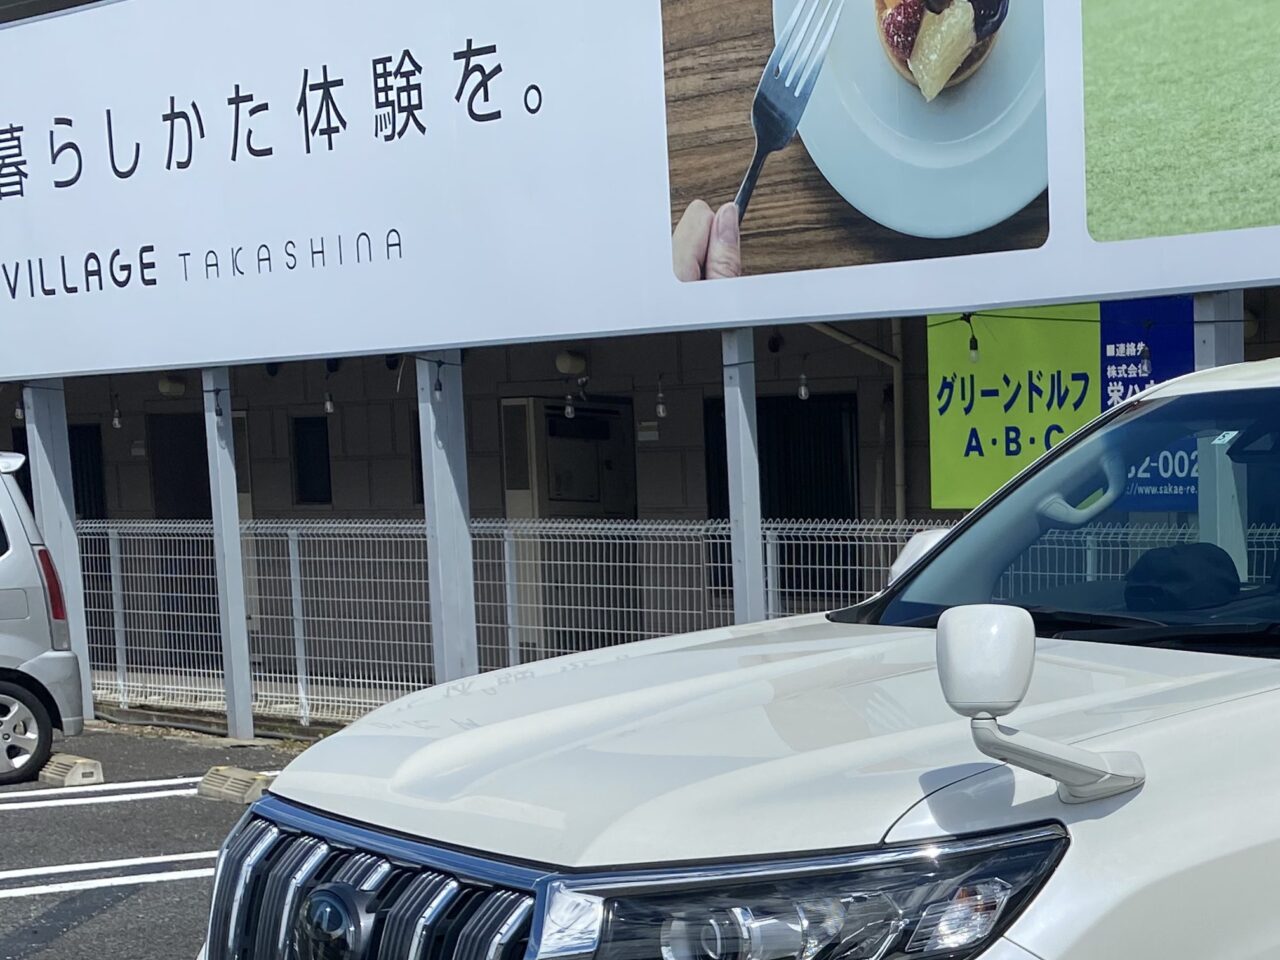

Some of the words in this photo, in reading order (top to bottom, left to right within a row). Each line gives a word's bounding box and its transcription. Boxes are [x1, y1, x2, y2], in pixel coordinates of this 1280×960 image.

[0, 244, 157, 300] VILLAGE
[178, 228, 403, 282] TAKASHINA
[936, 369, 1090, 416] グリーンドルフ
